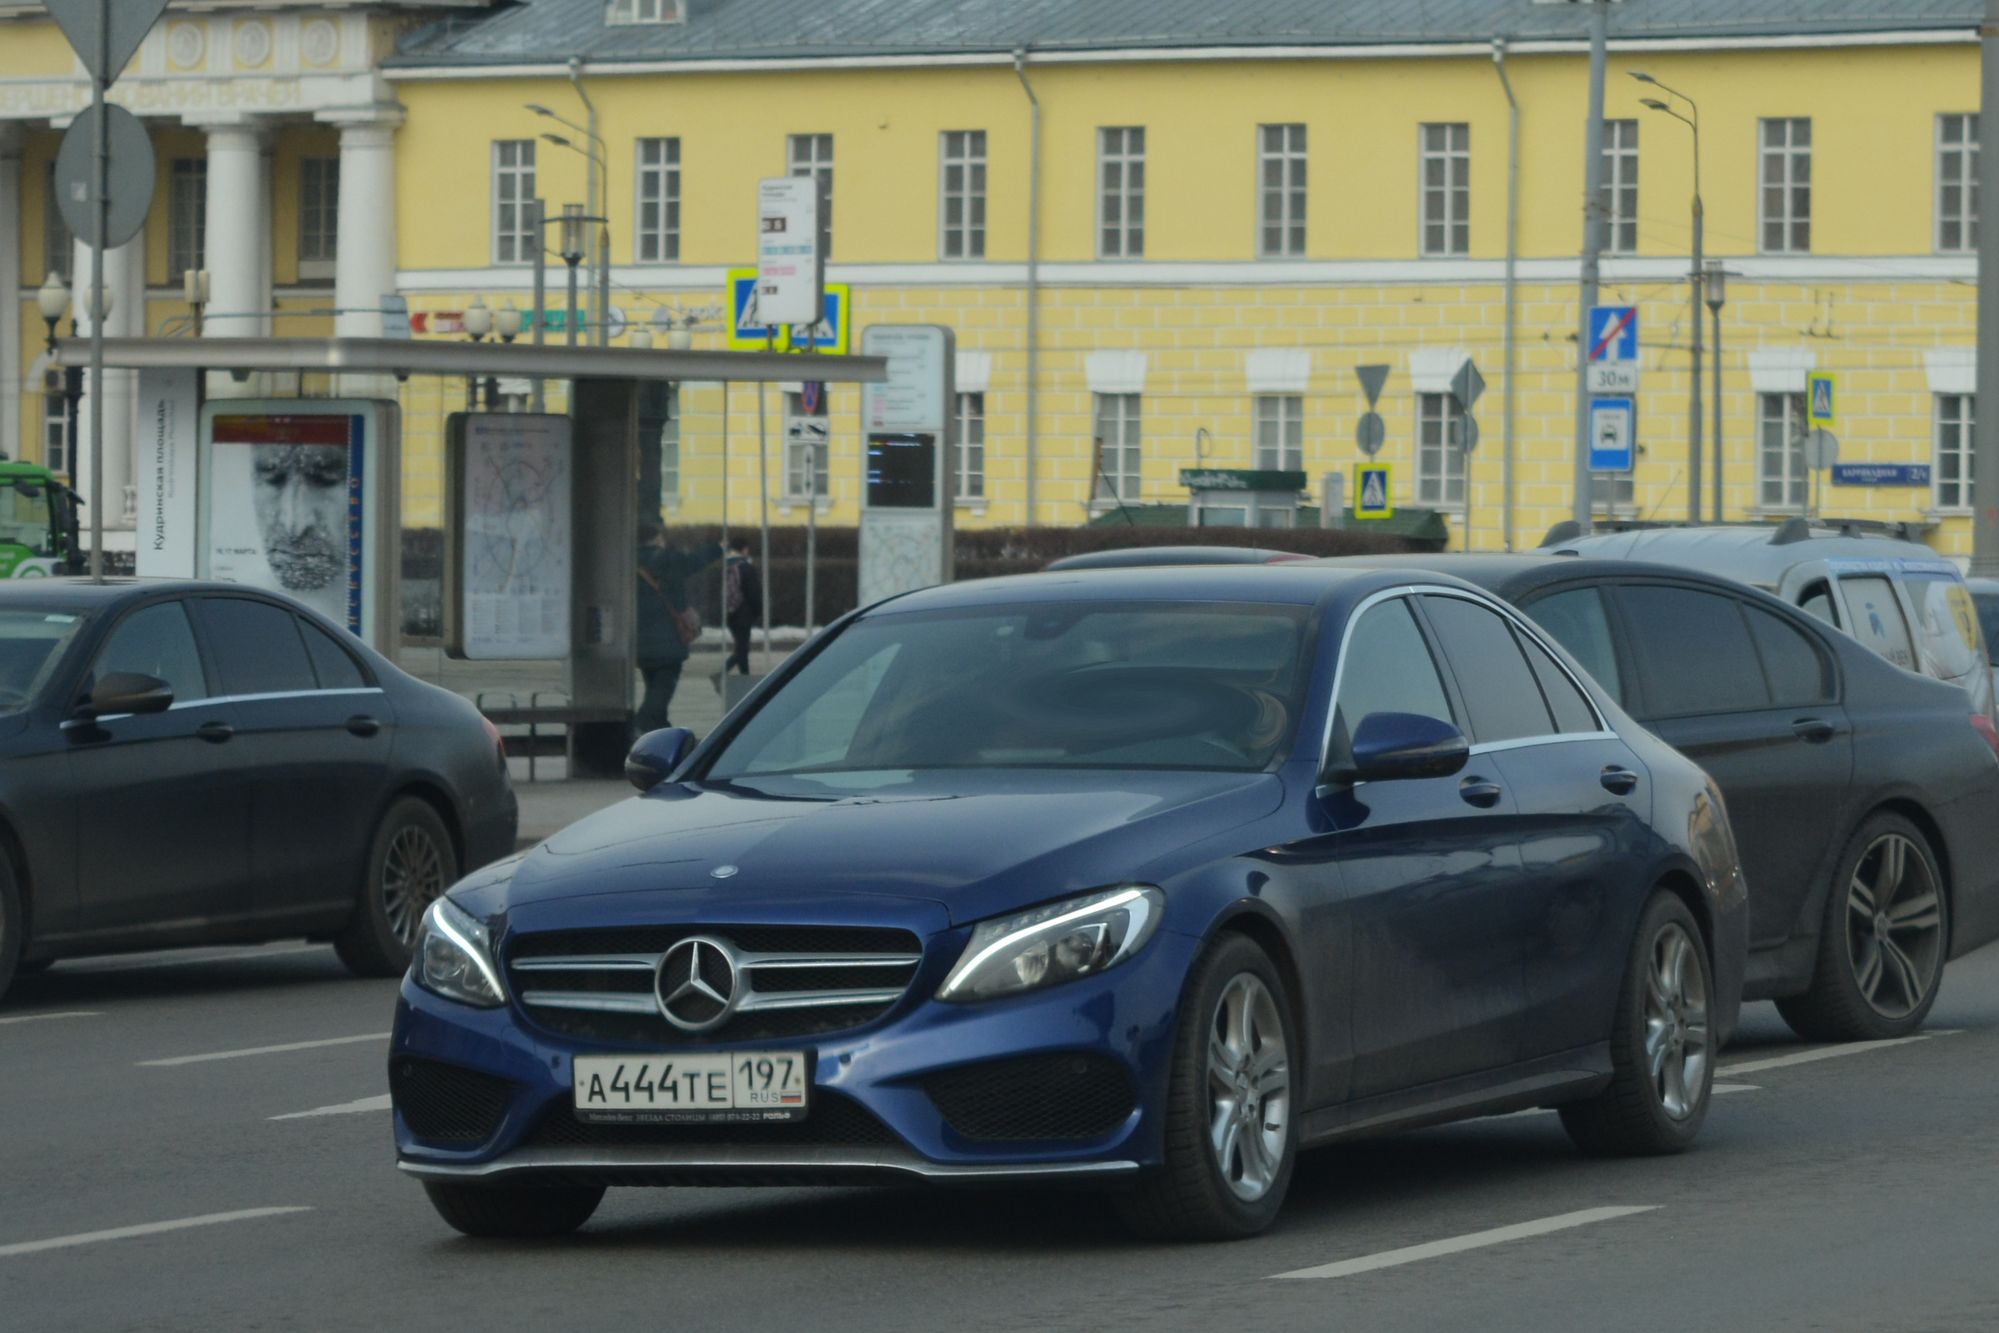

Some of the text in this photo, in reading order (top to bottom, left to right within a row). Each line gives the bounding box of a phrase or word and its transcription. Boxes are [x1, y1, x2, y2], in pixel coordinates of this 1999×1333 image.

[154, 399, 166, 550] Кудринская площадь
[588, 1058, 794, 1103] А444ТЕ 197
[750, 1091, 779, 1103] RUS
